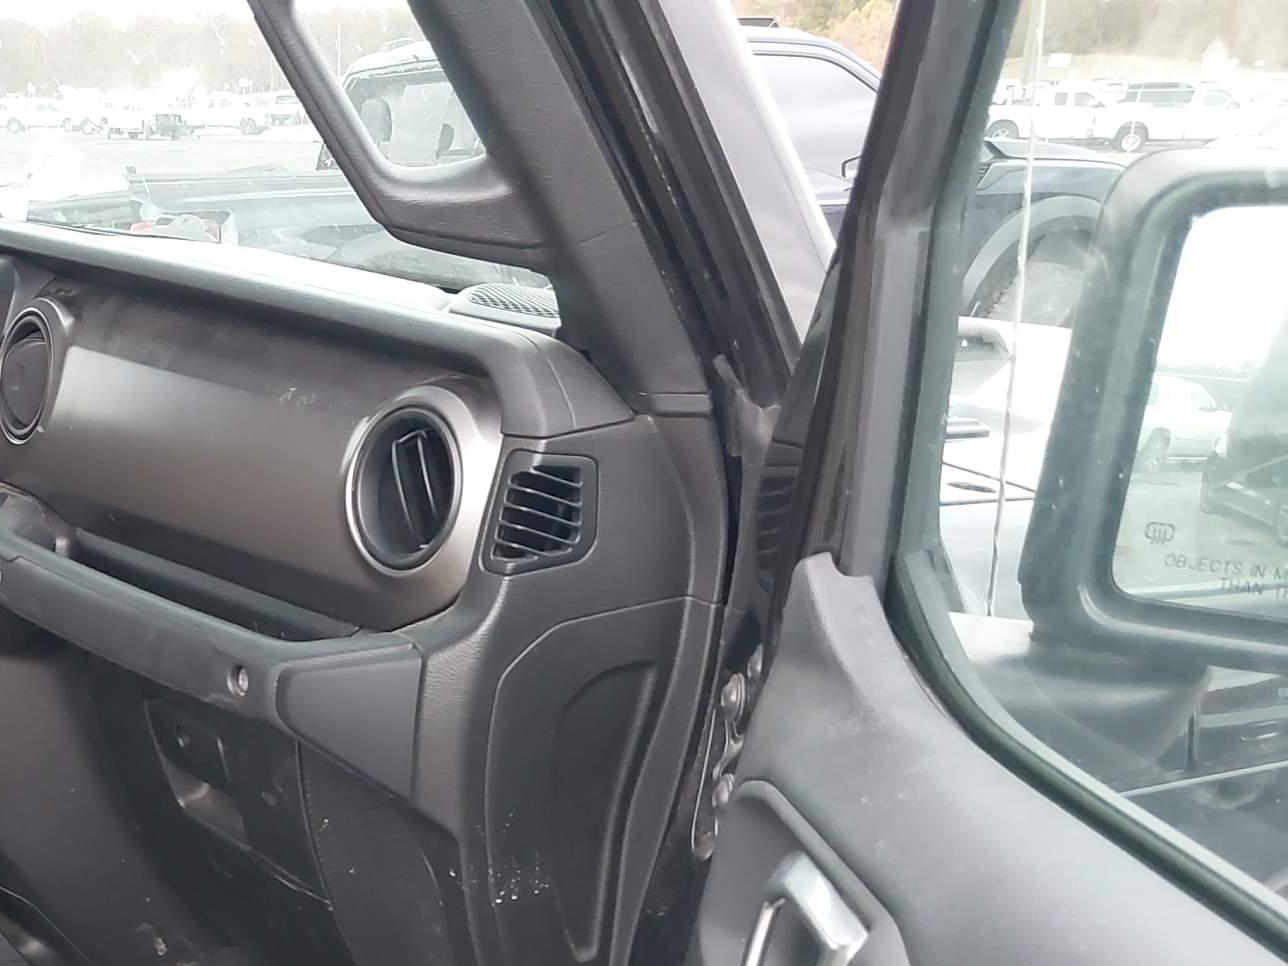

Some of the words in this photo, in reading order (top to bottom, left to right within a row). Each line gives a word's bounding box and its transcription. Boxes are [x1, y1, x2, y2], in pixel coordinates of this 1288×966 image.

[1164, 553, 1243, 575] OBJECTS
[1250, 563, 1267, 578] IN
[1220, 576, 1264, 596] THAN
